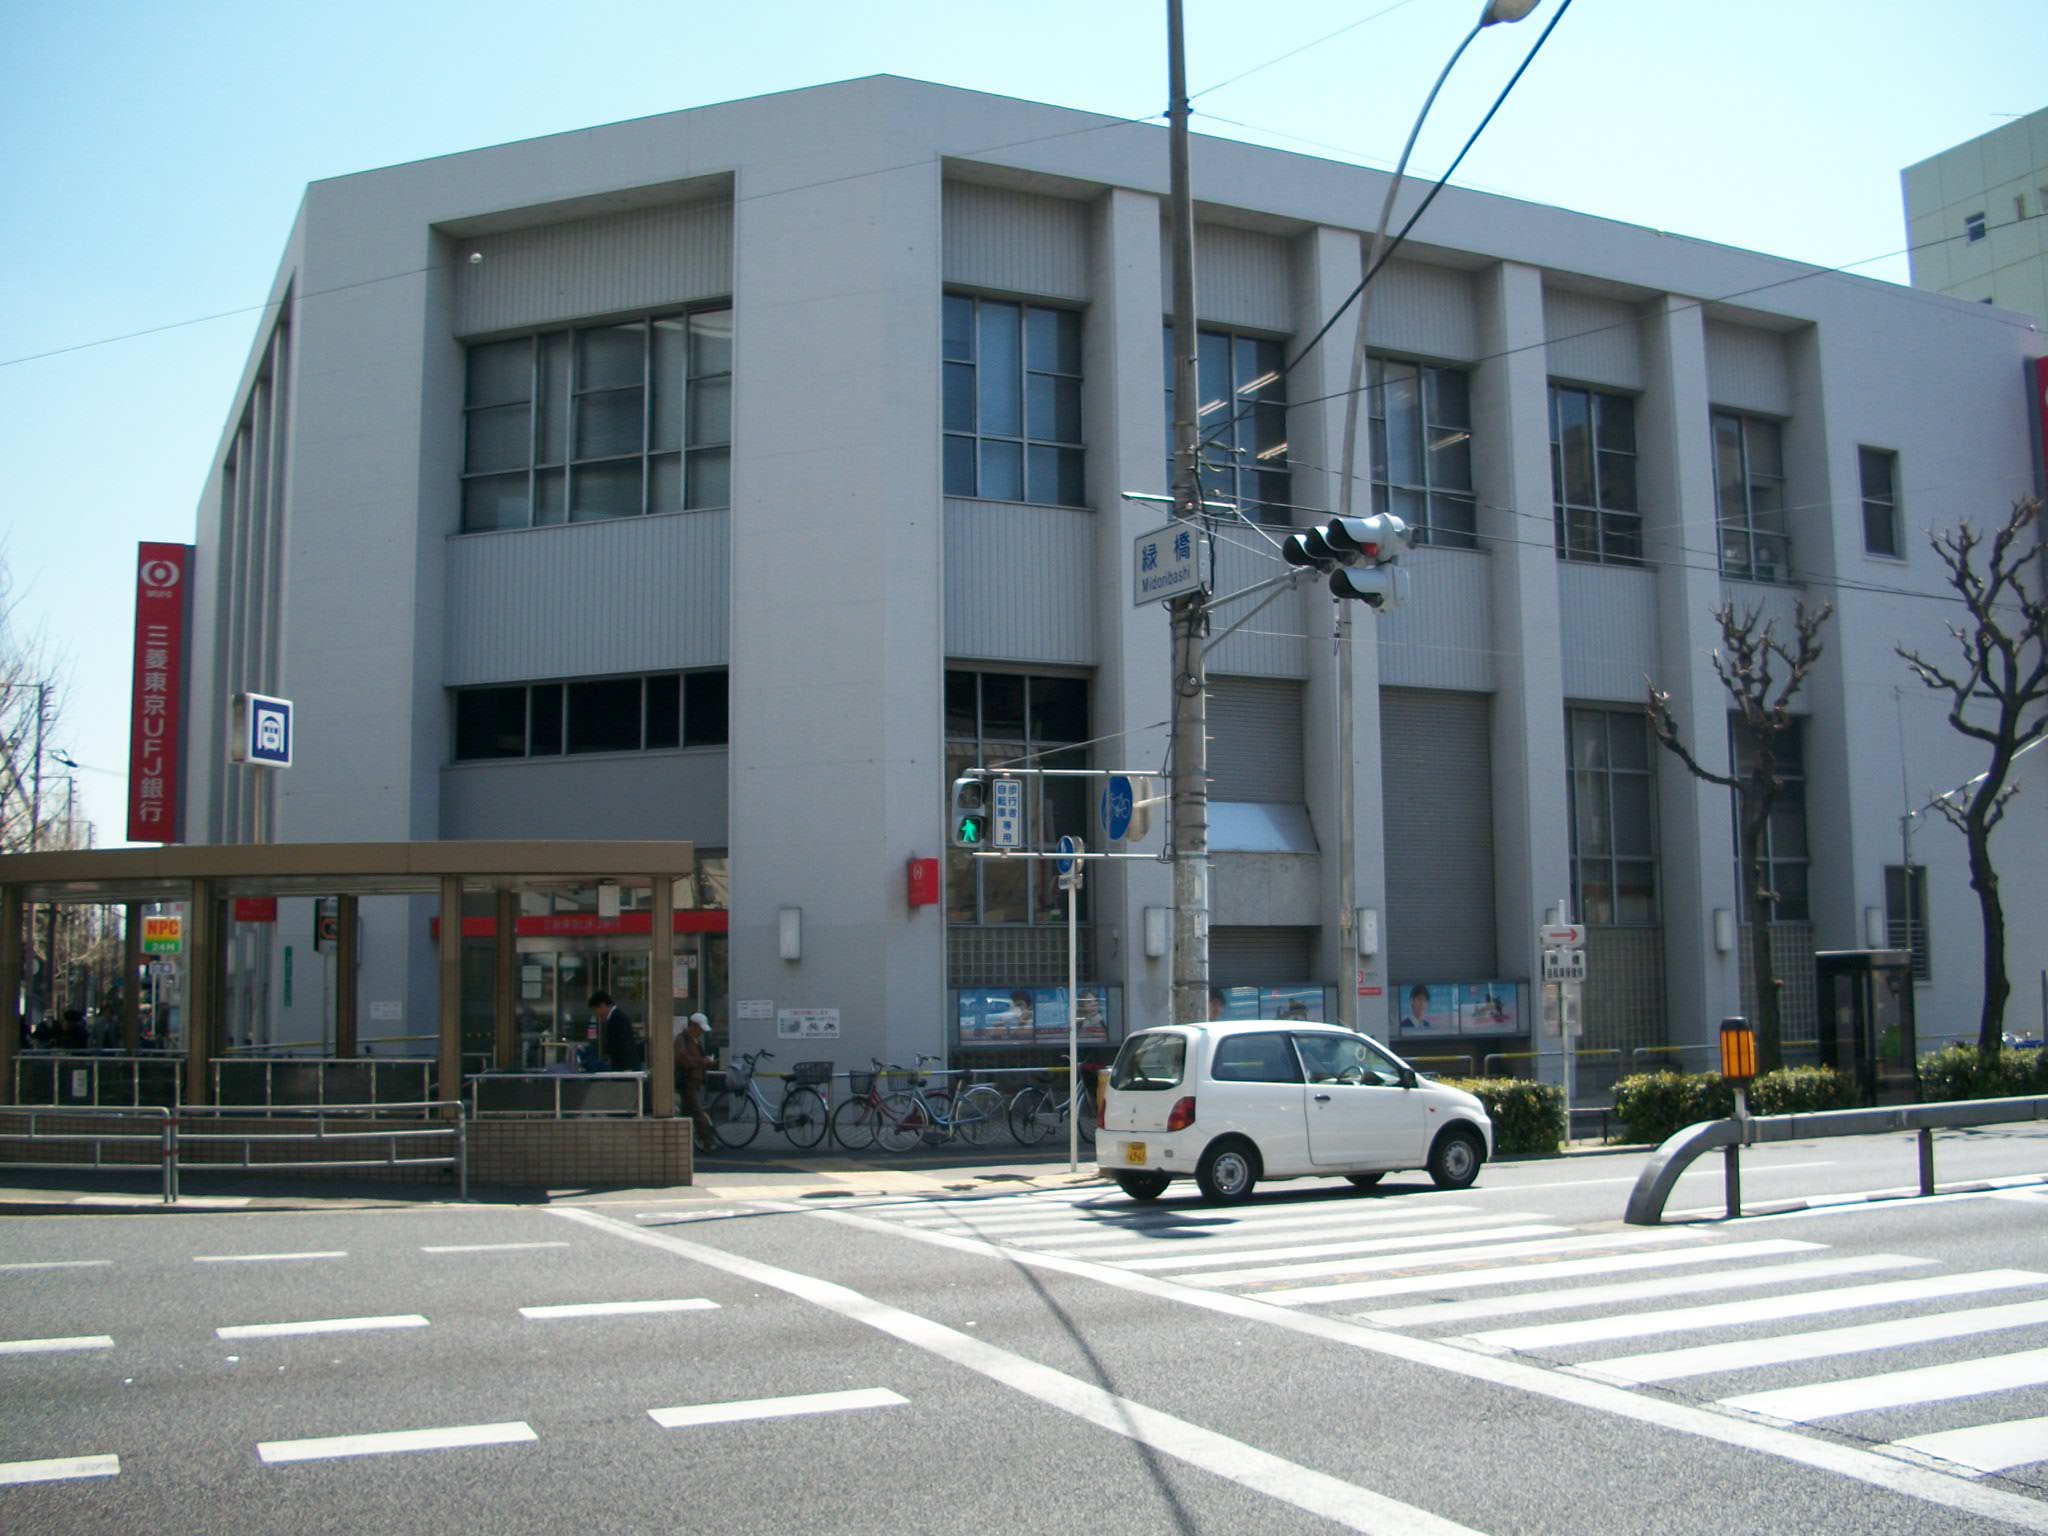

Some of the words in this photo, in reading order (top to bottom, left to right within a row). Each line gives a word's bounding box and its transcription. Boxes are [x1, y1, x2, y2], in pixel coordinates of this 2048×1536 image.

[1142, 531, 1191, 572] 緑橋
[1142, 564, 1191, 592] Midoribashi
[140, 626, 168, 822] 三菱東京UFJ銀行
[147, 919, 178, 936] NPC
